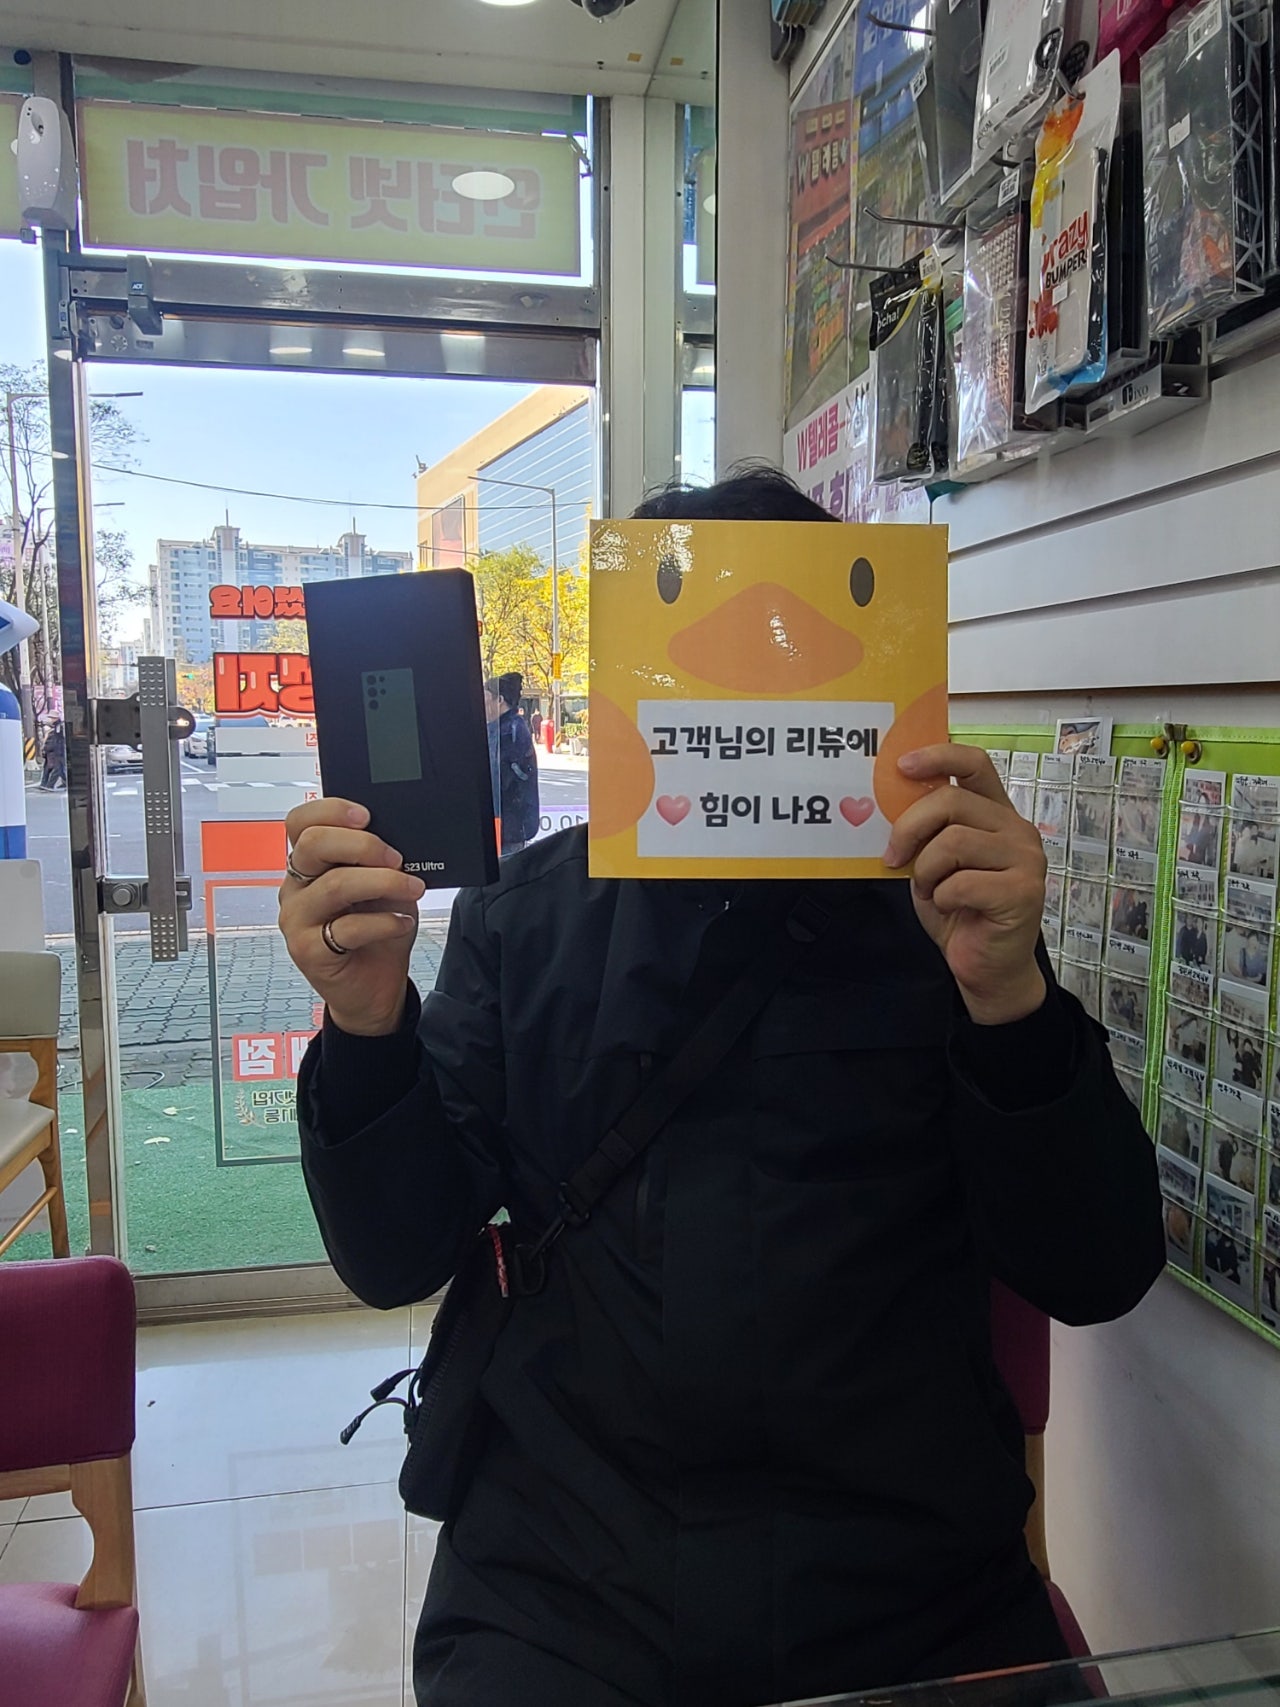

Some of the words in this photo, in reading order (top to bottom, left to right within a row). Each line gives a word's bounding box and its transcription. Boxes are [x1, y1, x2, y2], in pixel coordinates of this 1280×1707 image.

[650, 725, 775, 760] 고객님의
[786, 726, 878, 759] 리뷰에
[699, 792, 761, 828] 힘이
[772, 796, 832, 825] 나요
[404, 863, 420, 872] S23
[421, 862, 445, 871] Ultra
